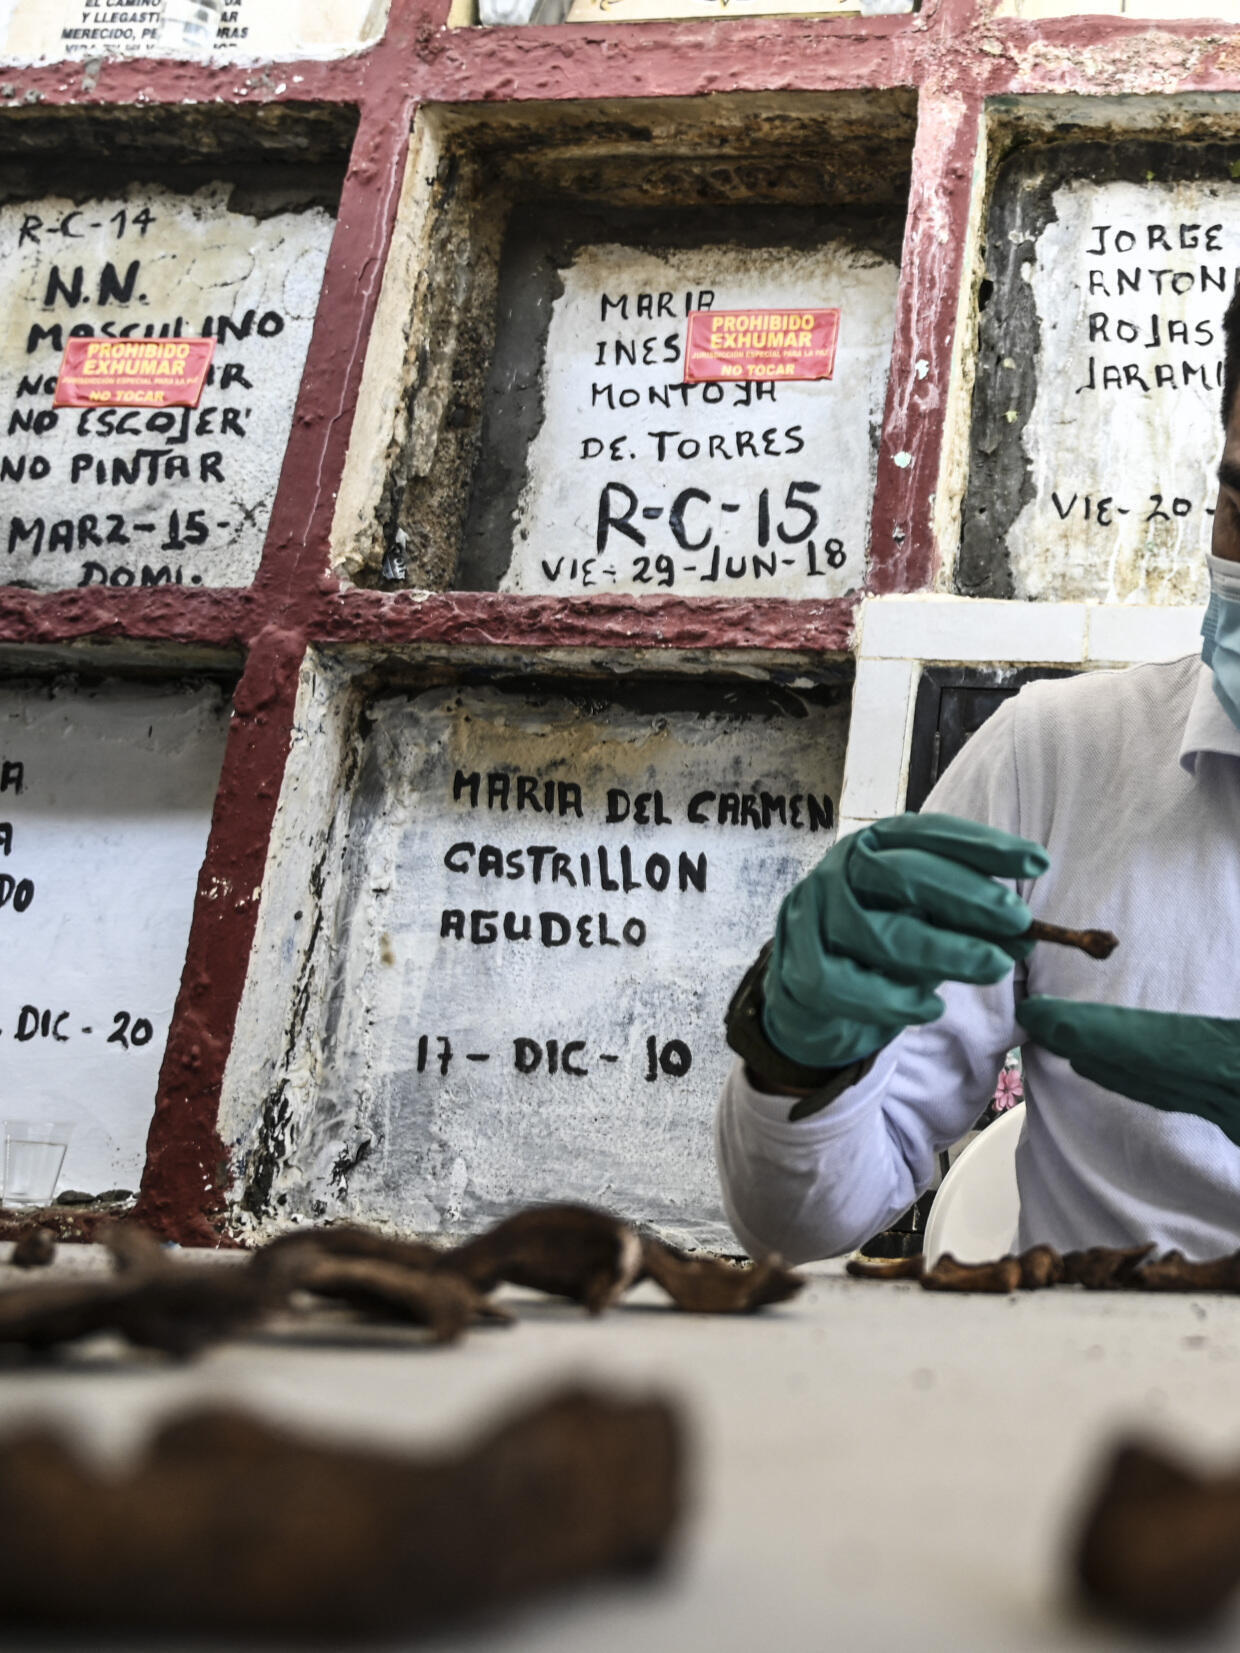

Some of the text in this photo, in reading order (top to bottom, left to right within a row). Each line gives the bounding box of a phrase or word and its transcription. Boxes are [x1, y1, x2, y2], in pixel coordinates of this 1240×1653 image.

[82, 12, 91, 23] Y
[61, 28, 136, 40] MERECIDO,
[1086, 223, 1223, 255] JORGE
[44, 260, 147, 308] N.N.
[601, 290, 715, 321] MARIA
[712, 314, 815, 332] PROHIBIDO
[1089, 312, 1214, 348] ROJAS
[87, 342, 190, 359] PROHIBIDO
[595, 333, 681, 366] INES
[710, 331, 812, 349] EXHUMAR
[82, 359, 186, 375] EXHUMAR
[721, 363, 795, 376] NO TOCAR
[1075, 357, 1223, 394] JARAMI
[89, 390, 165, 402] NO TOCAR
[8, 408, 58, 436] NO
[648, 426, 805, 462] TORRES
[0, 449, 225, 486] NO PINTAR
[597, 481, 821, 555] R-C-15
[453, 770, 833, 831] MARIA DEL CARMEN
[443, 842, 707, 893] CASTRILLON
[440, 909, 647, 948] AGUDELO
